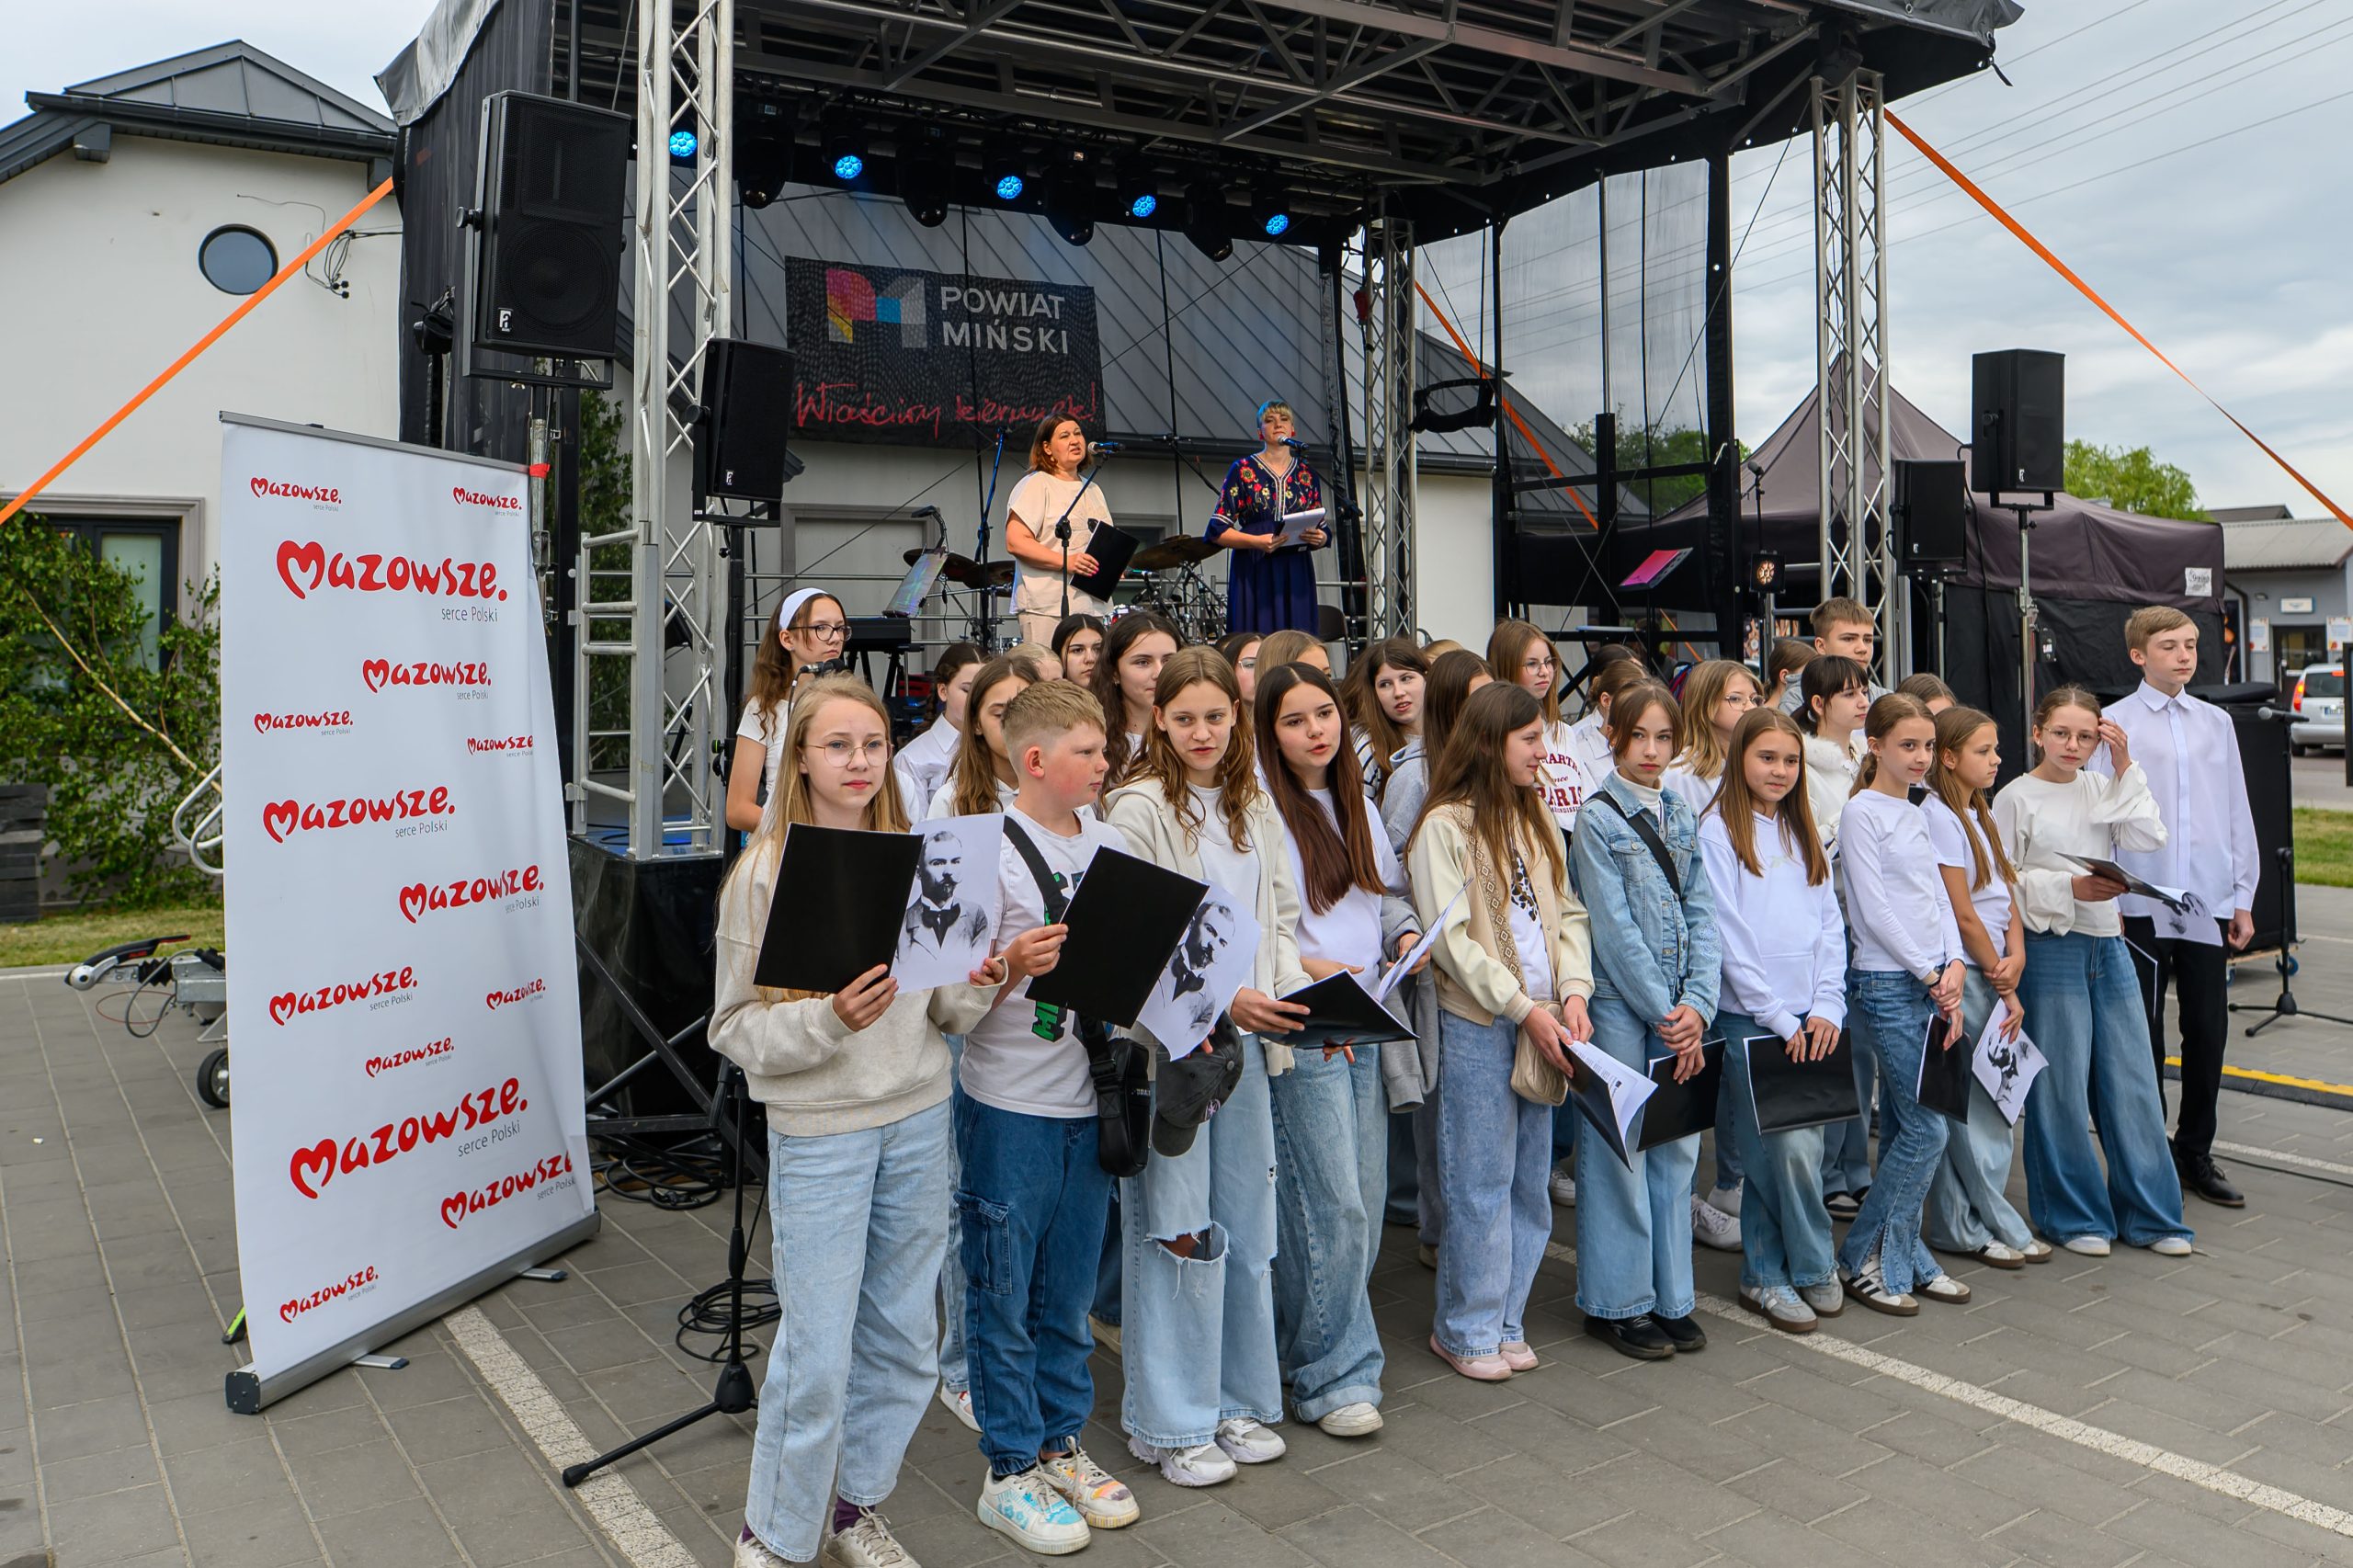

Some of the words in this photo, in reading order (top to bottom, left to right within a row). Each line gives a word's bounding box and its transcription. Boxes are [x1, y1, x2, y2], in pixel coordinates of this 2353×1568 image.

[941, 287, 1064, 319] POWIAT
[942, 319, 1067, 354] MIŃSKI
[250, 477, 341, 505] Mazowsze.
[453, 487, 522, 510] Mazowsze.
[277, 540, 507, 601] Mazowsze.
[441, 608, 468, 621] serce
[471, 606, 498, 622] Polski
[363, 659, 492, 694] Mazowsze.
[456, 691, 471, 700] serce
[472, 689, 489, 699] Polski
[254, 710, 354, 733] Mazowsze.
[263, 786, 456, 844] Mazowsze.
[395, 825, 416, 838] serce
[419, 819, 448, 835] Polski
[399, 865, 544, 924] Mazowsze.
[515, 895, 540, 910] Polski
[269, 966, 418, 1026] Mazowsze.
[369, 999, 390, 1012] serce
[391, 992, 413, 1006] Polski
[365, 1037, 455, 1077] Mazowsze.
[290, 1077, 528, 1199] Mazowsze.
[458, 1136, 488, 1158] serce
[491, 1119, 520, 1143] Polski
[537, 1186, 554, 1200] serce
[279, 1265, 379, 1324] Mazowsze.
